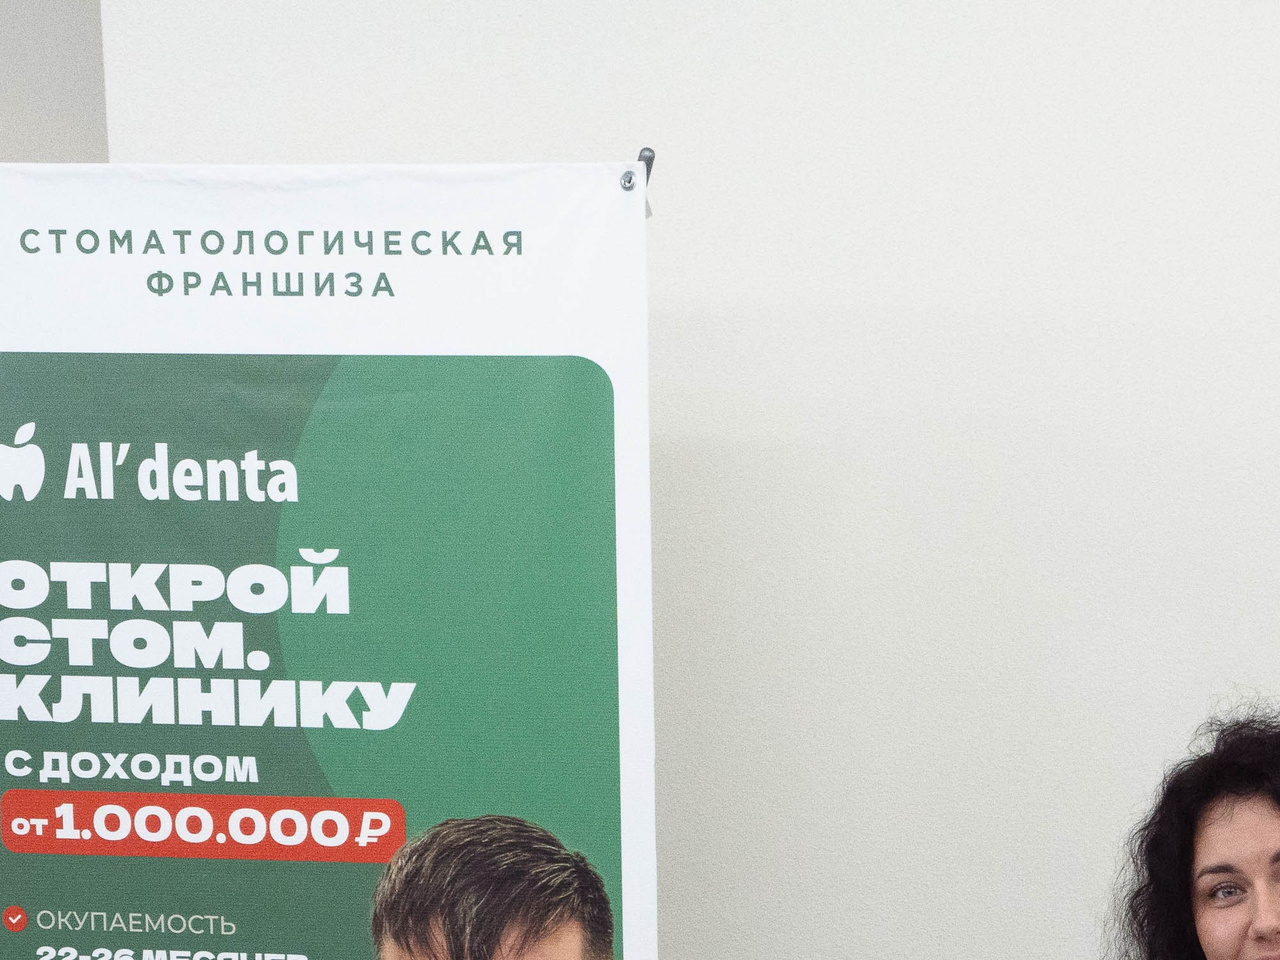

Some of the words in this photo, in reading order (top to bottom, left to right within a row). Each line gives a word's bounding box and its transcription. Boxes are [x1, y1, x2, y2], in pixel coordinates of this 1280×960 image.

[19, 228, 525, 257] СТОМАТОЛОГИЧЕСКАЯ
[146, 270, 396, 298] ФРАНШИЗА
[0, 548, 350, 615] ОТКРОЙ
[0, 616, 271, 671] СТОМ.
[0, 673, 417, 731] КЛИНИКУ
[4, 749, 33, 778] С
[39, 751, 260, 787] ДОХОДОМ
[10, 816, 49, 837] от
[36, 909, 237, 936] ОКУПАЕМОСТЬ
